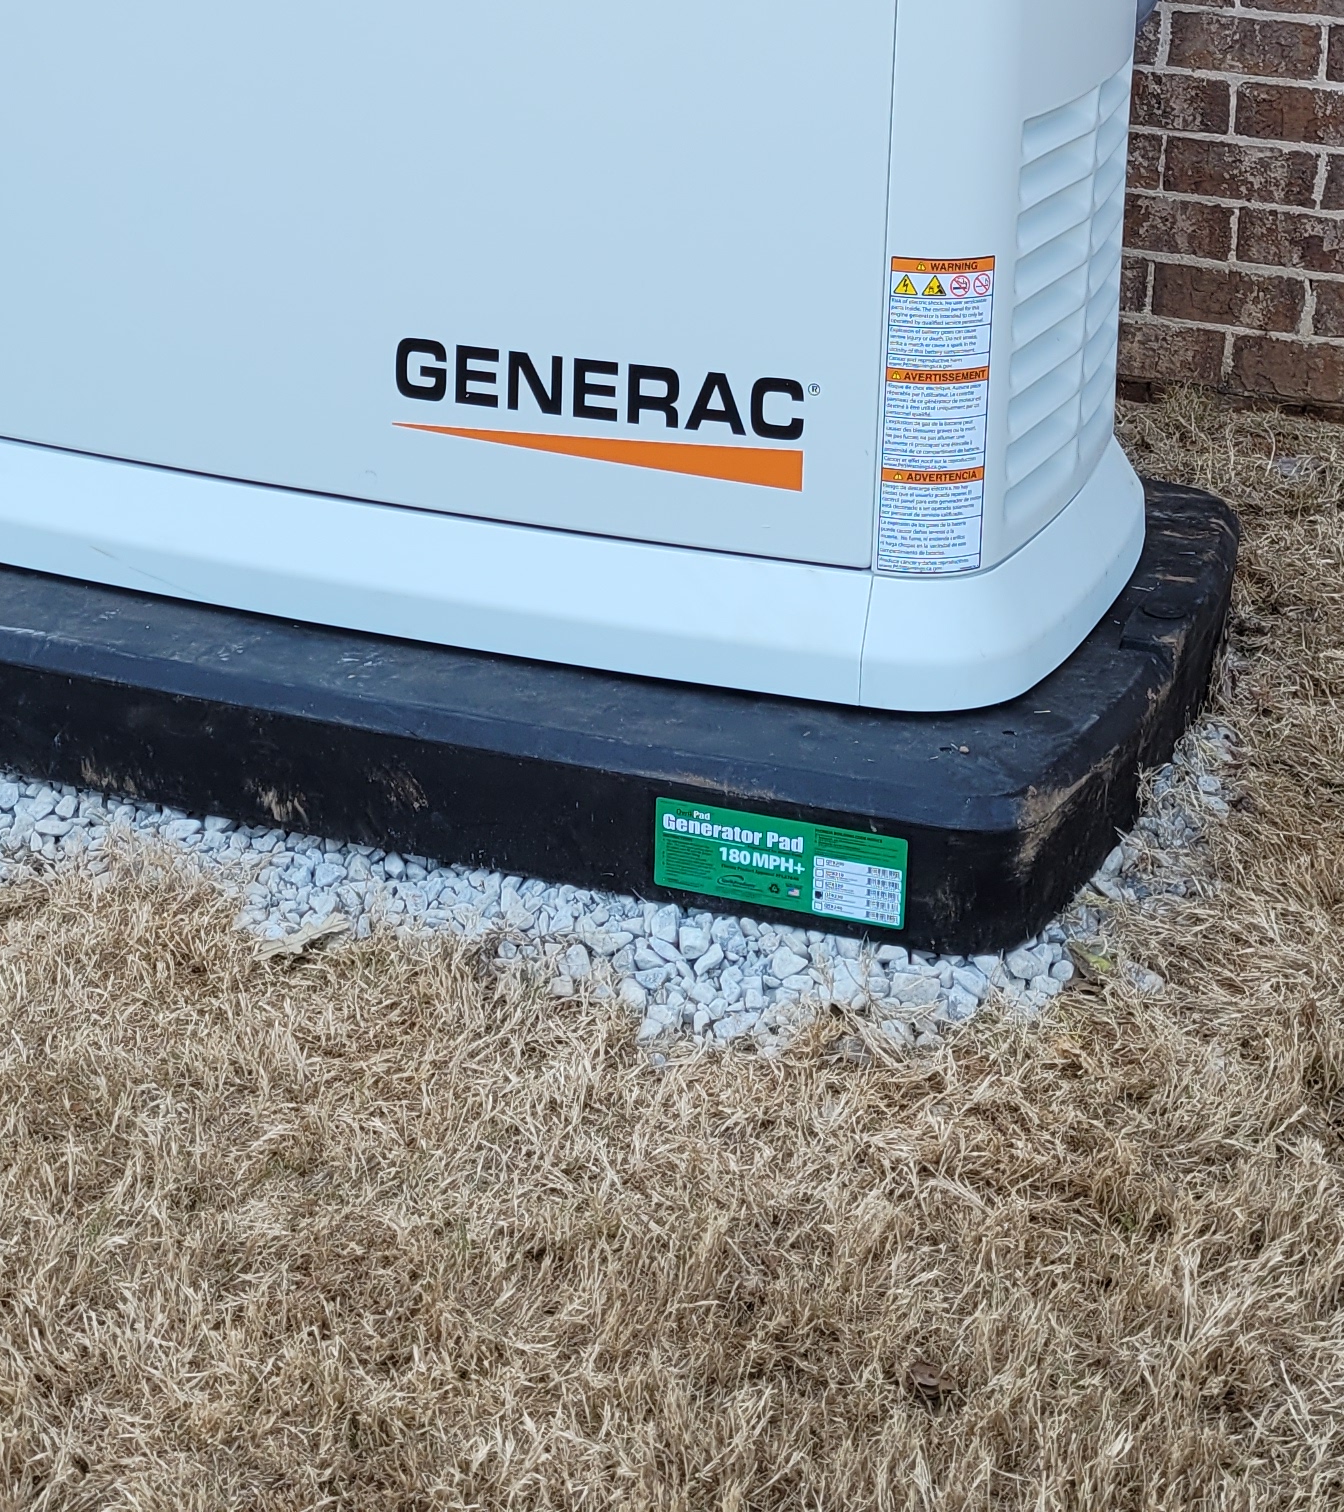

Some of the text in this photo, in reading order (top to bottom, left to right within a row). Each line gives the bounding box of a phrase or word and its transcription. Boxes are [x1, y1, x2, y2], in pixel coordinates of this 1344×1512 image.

[930, 262, 978, 272] WARNING
[904, 370, 987, 382] AVERTISSEMENT
[907, 470, 977, 482] ADVERTENCIA
[662, 813, 762, 845] Generator
[766, 831, 804, 853] Pad
[719, 847, 751, 865] 180
[752, 852, 805, 875] MPH+
